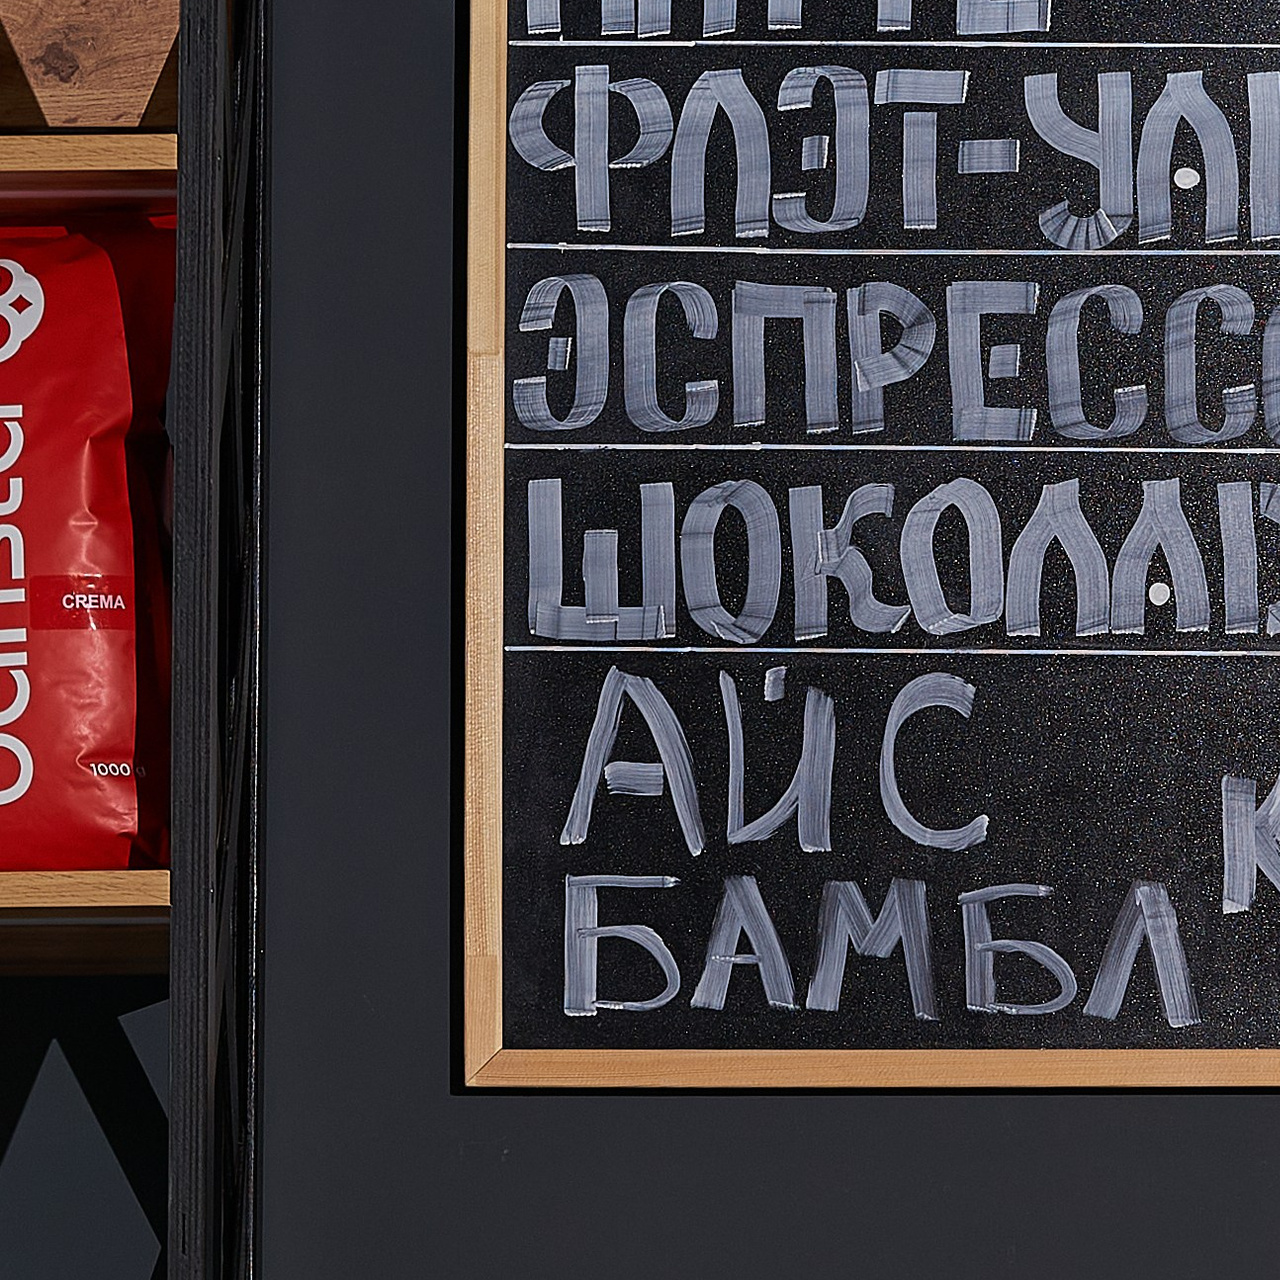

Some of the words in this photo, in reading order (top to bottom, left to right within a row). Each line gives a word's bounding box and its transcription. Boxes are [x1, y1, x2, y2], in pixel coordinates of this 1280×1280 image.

[61, 593, 127, 611] CREMA
[89, 761, 132, 778] 1000
[560, 665, 990, 857] АЙС
[563, 875, 1202, 1028] БАМБЛ
